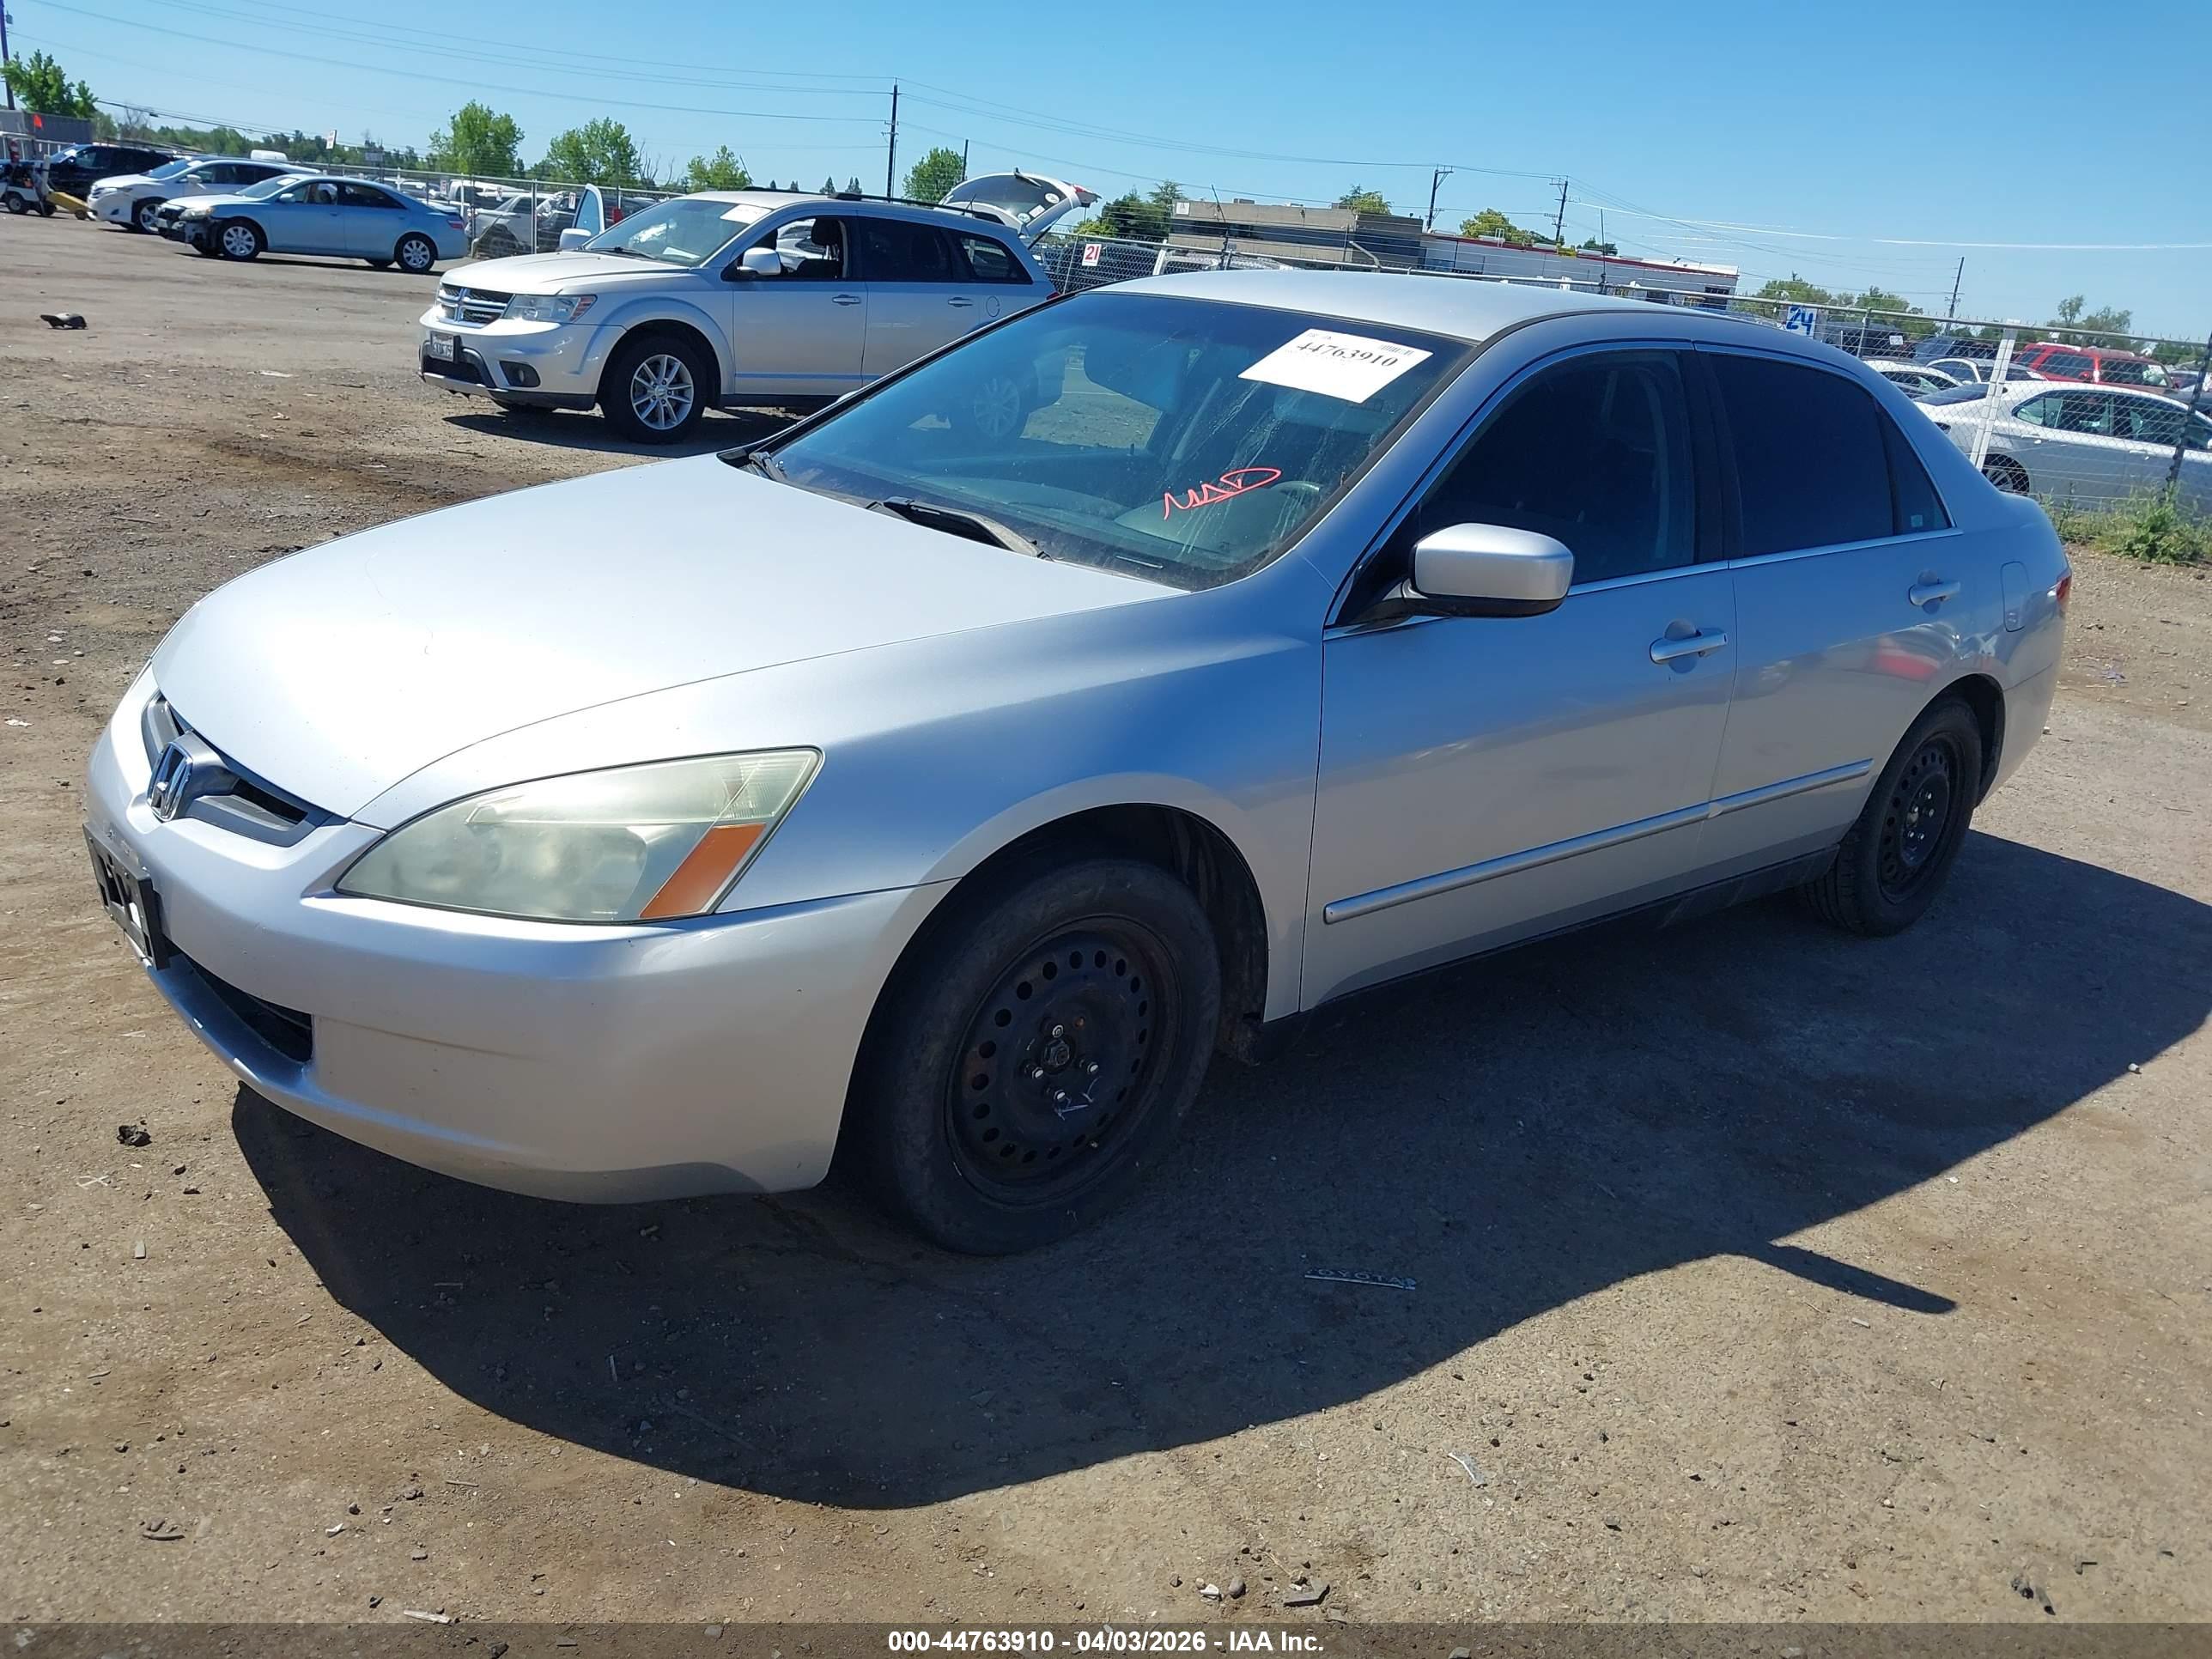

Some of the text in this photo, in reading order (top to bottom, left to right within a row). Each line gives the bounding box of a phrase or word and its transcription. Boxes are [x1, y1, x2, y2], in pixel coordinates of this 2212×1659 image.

[1085, 246, 1100, 260] 21
[1786, 307, 1814, 336] 24
[1297, 342, 1399, 368] 44763910
